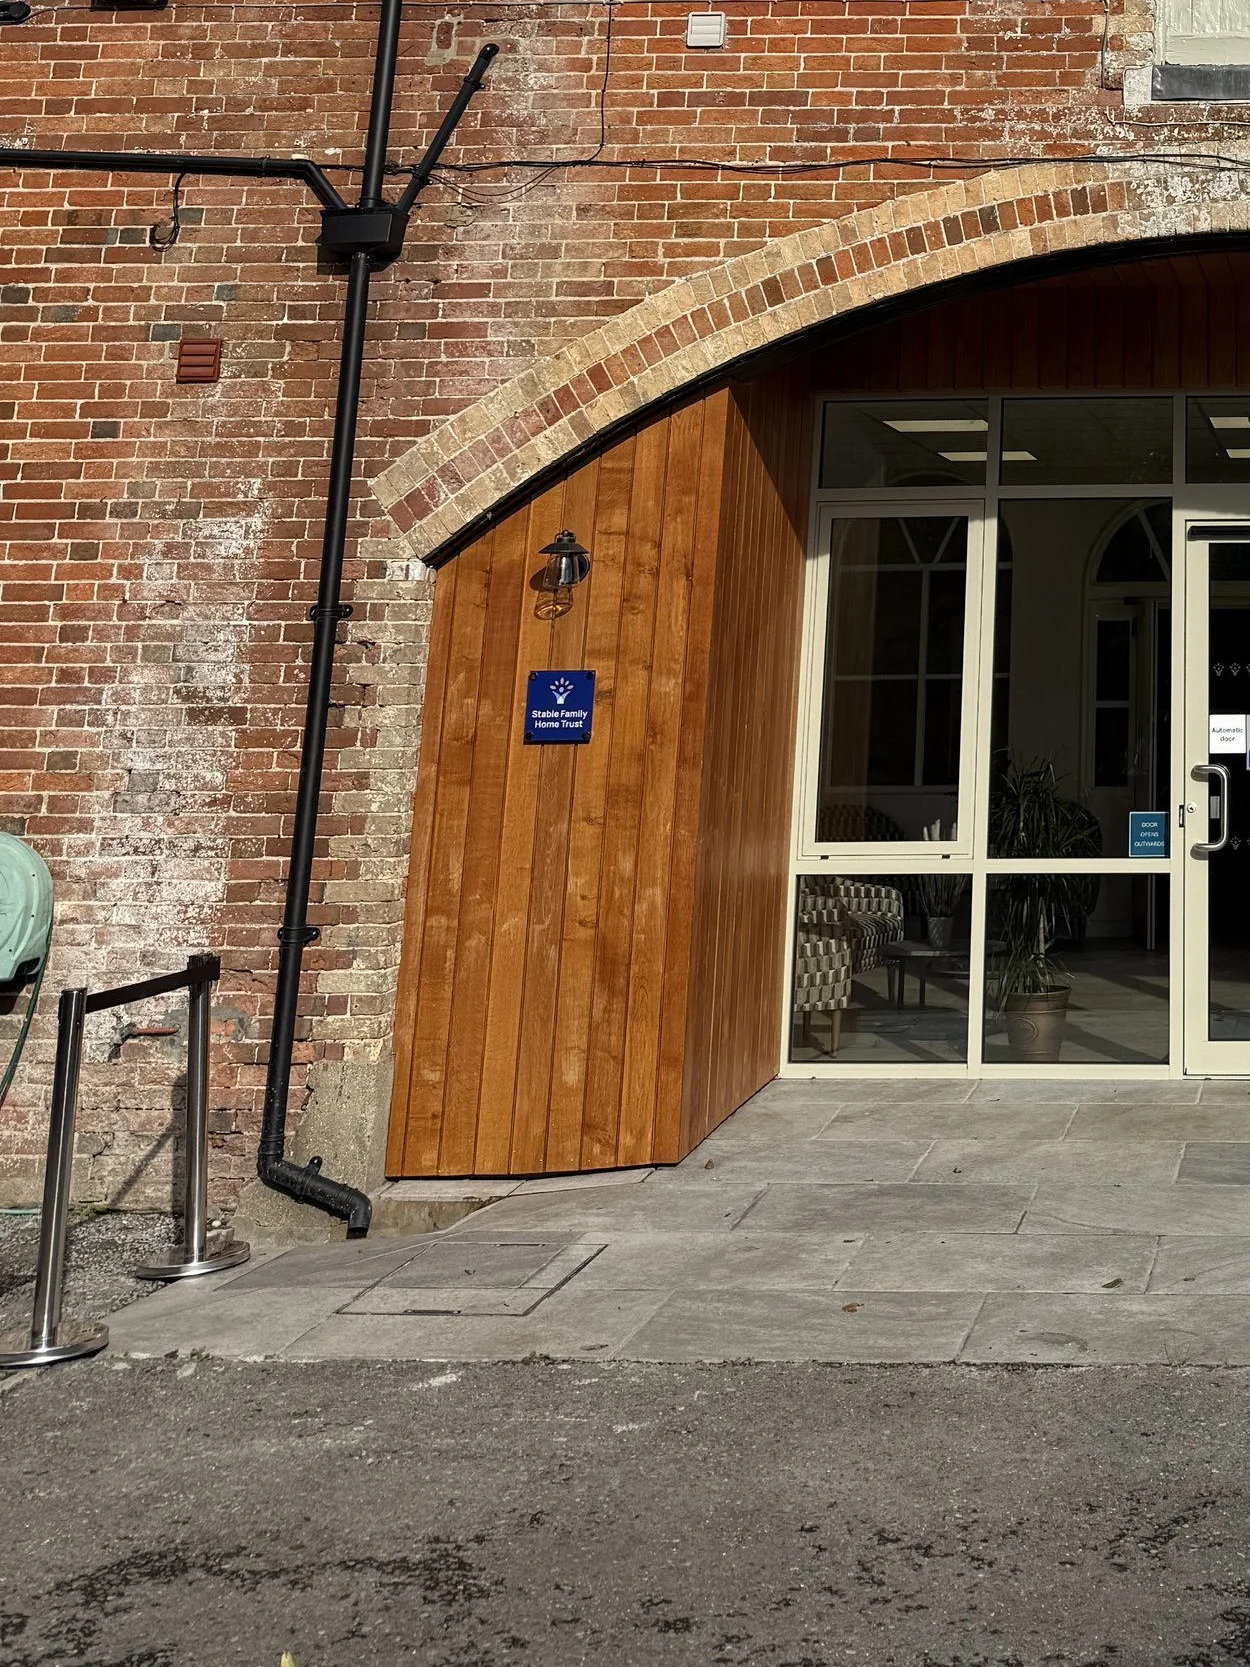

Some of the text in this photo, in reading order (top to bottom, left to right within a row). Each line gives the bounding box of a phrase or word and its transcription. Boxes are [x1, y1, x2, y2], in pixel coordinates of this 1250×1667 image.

[531, 710, 588, 719] Stable Family
[534, 720, 583, 728] Home Trust
